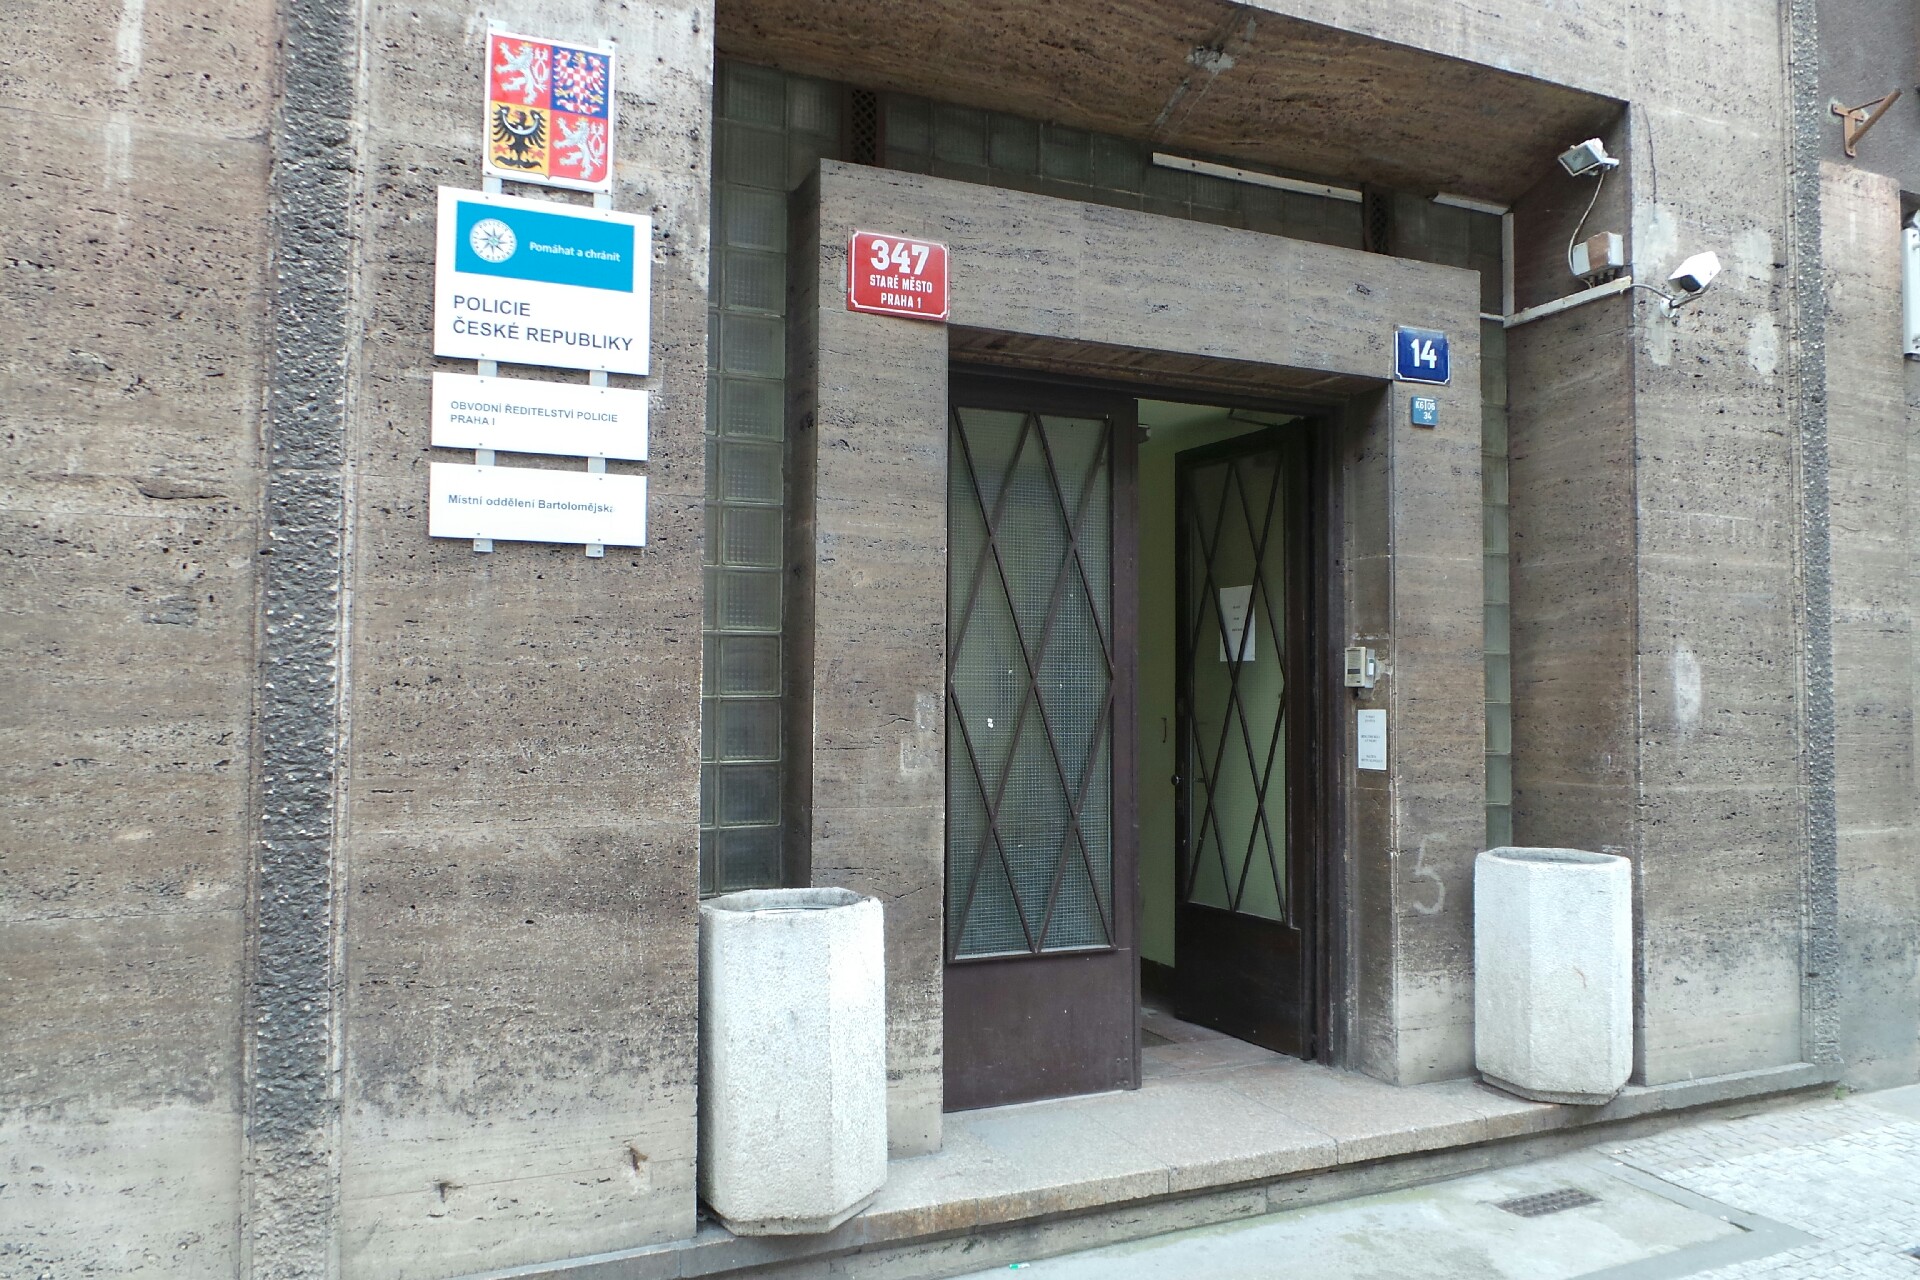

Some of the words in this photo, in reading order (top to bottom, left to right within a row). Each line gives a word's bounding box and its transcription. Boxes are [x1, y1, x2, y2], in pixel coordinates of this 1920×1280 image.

[529, 241, 575, 257] Pomáhat
[576, 249, 584, 257] a
[585, 248, 621, 262] chránit
[870, 239, 930, 275] 347
[869, 274, 899, 289] STARÉ
[902, 276, 933, 293] MĚSTO
[453, 295, 531, 317] POLICIE
[880, 292, 914, 309] PRAHA
[916, 297, 922, 309] 1
[452, 316, 520, 340] ČESKÉ
[526, 327, 633, 351] REPUBLIKY
[1410, 338, 1438, 369] 14
[450, 400, 502, 413] OBVODNÍ
[504, 403, 574, 419] ŘEDITELSTVÍ
[577, 411, 618, 423] POLICIE
[450, 414, 490, 426] PRAHA
[448, 494, 483, 505] Místní
[486, 497, 535, 509] oddělení
